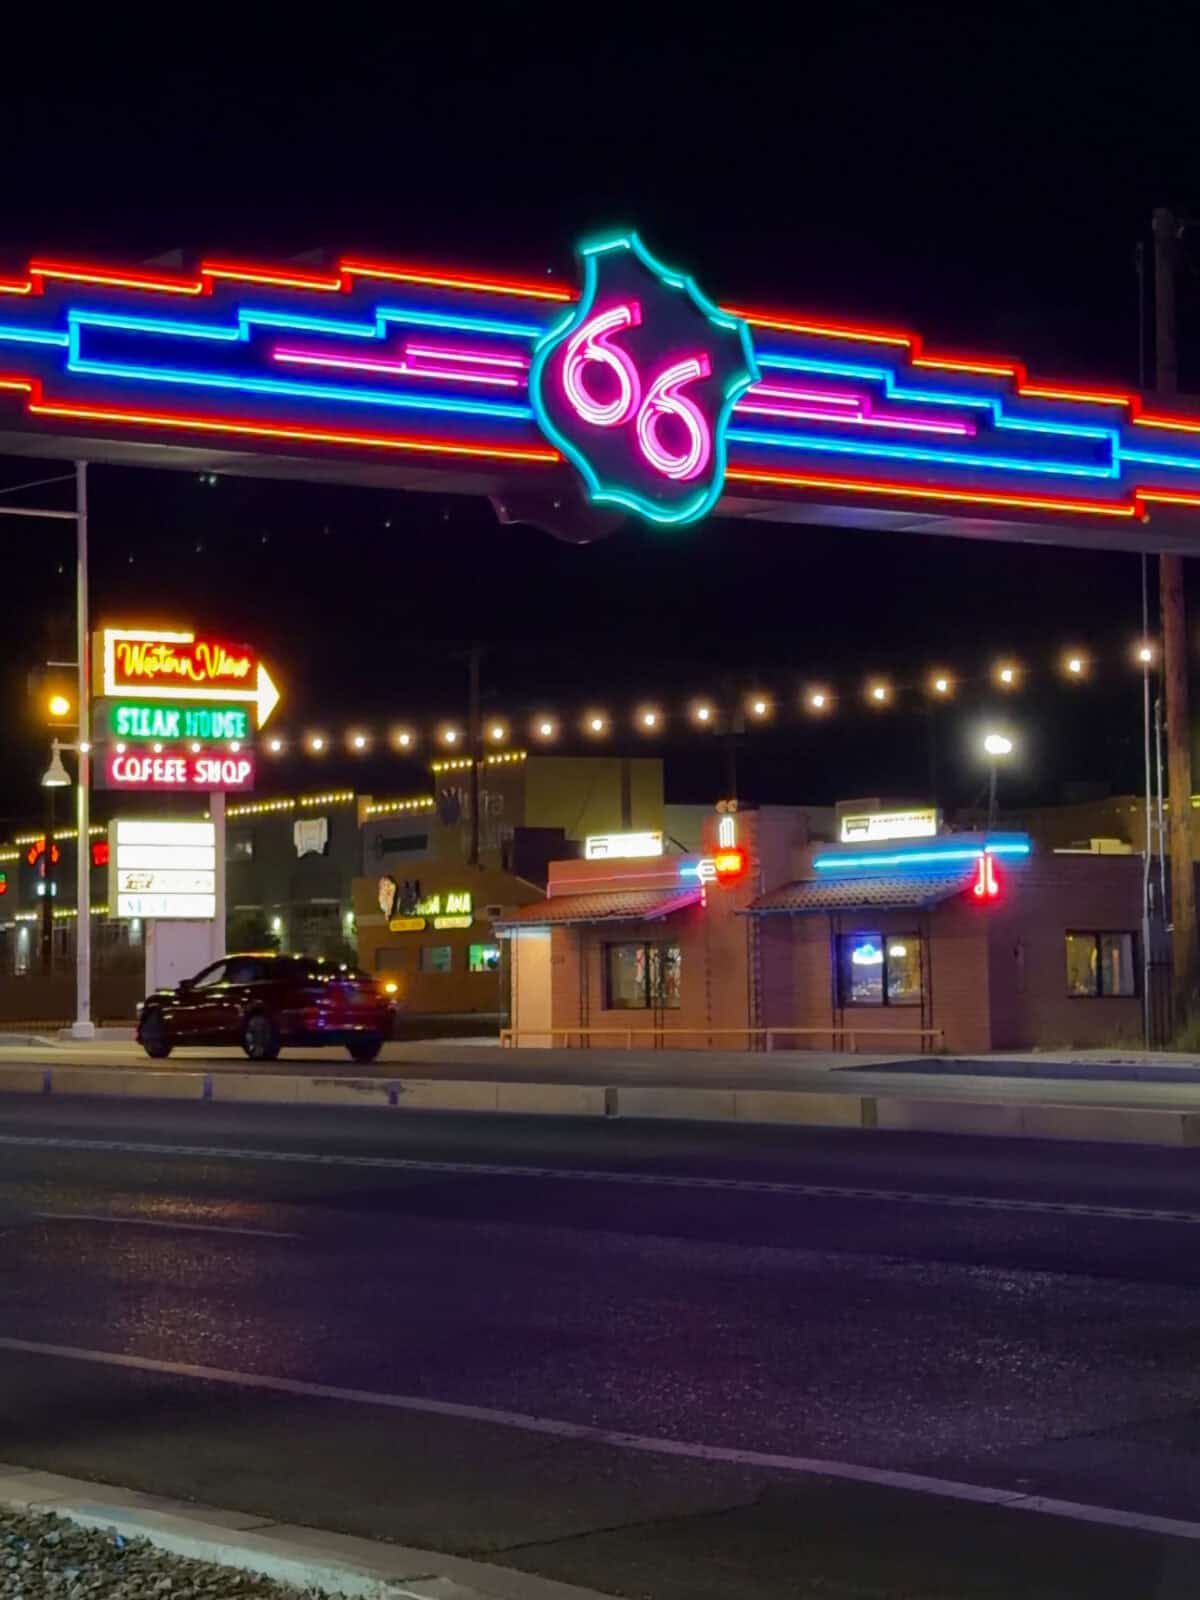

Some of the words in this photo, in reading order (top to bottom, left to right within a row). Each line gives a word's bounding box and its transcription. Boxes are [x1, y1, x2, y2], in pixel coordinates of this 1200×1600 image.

[563, 302, 711, 480] 66
[118, 643, 205, 680] Western
[196, 642, 251, 678] View
[117, 707, 180, 737] STEAK
[186, 711, 246, 738] HOUSE
[112, 756, 187, 782] COFFEE
[193, 760, 250, 784] SHOP
